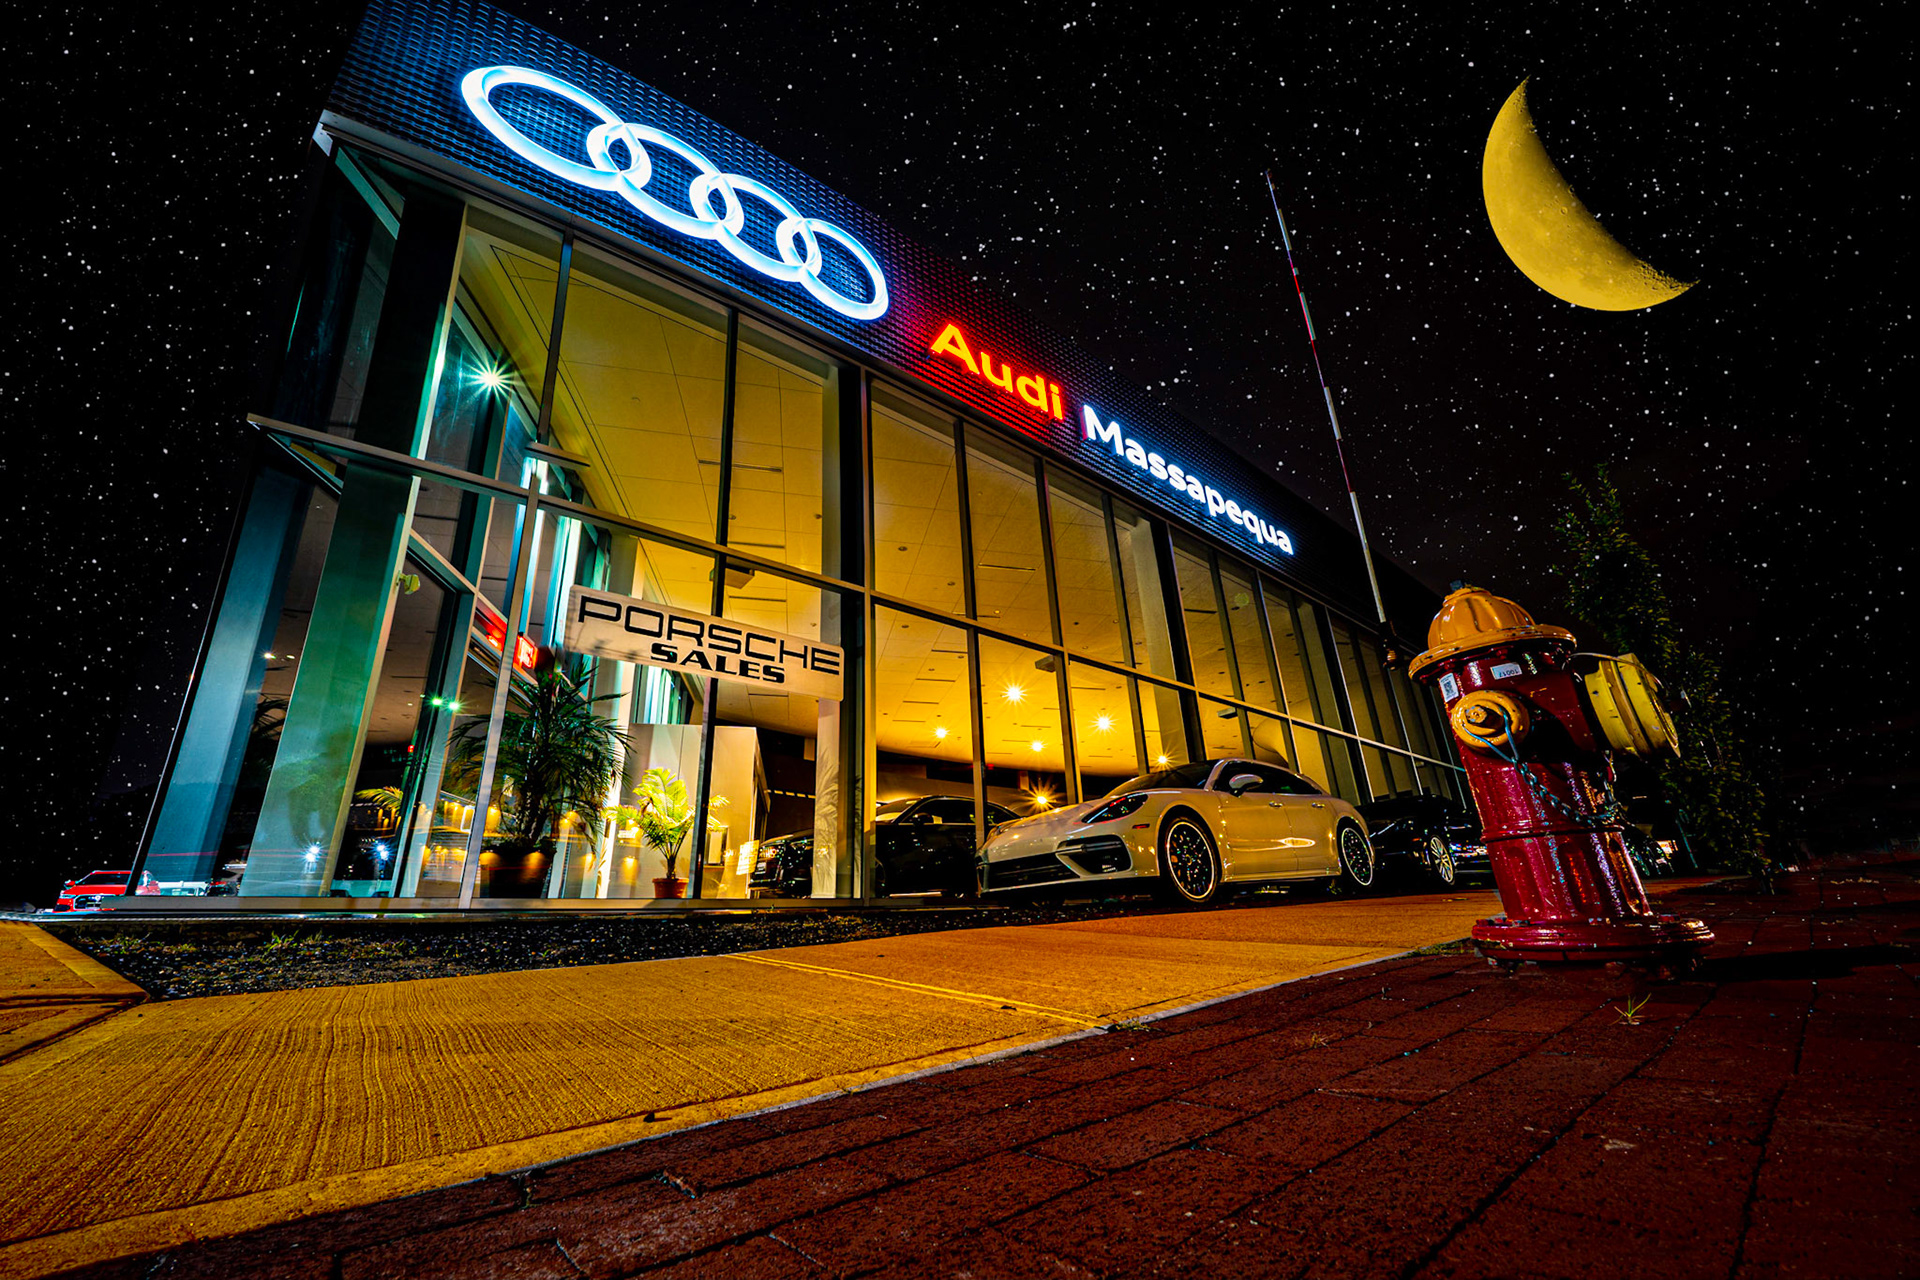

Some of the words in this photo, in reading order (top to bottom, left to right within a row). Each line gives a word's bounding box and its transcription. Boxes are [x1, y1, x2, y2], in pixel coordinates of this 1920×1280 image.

[930, 323, 1064, 421] Audi
[1081, 404, 1294, 555] Massapequa
[578, 595, 840, 675] PORSCHE
[650, 642, 785, 683] SALES
